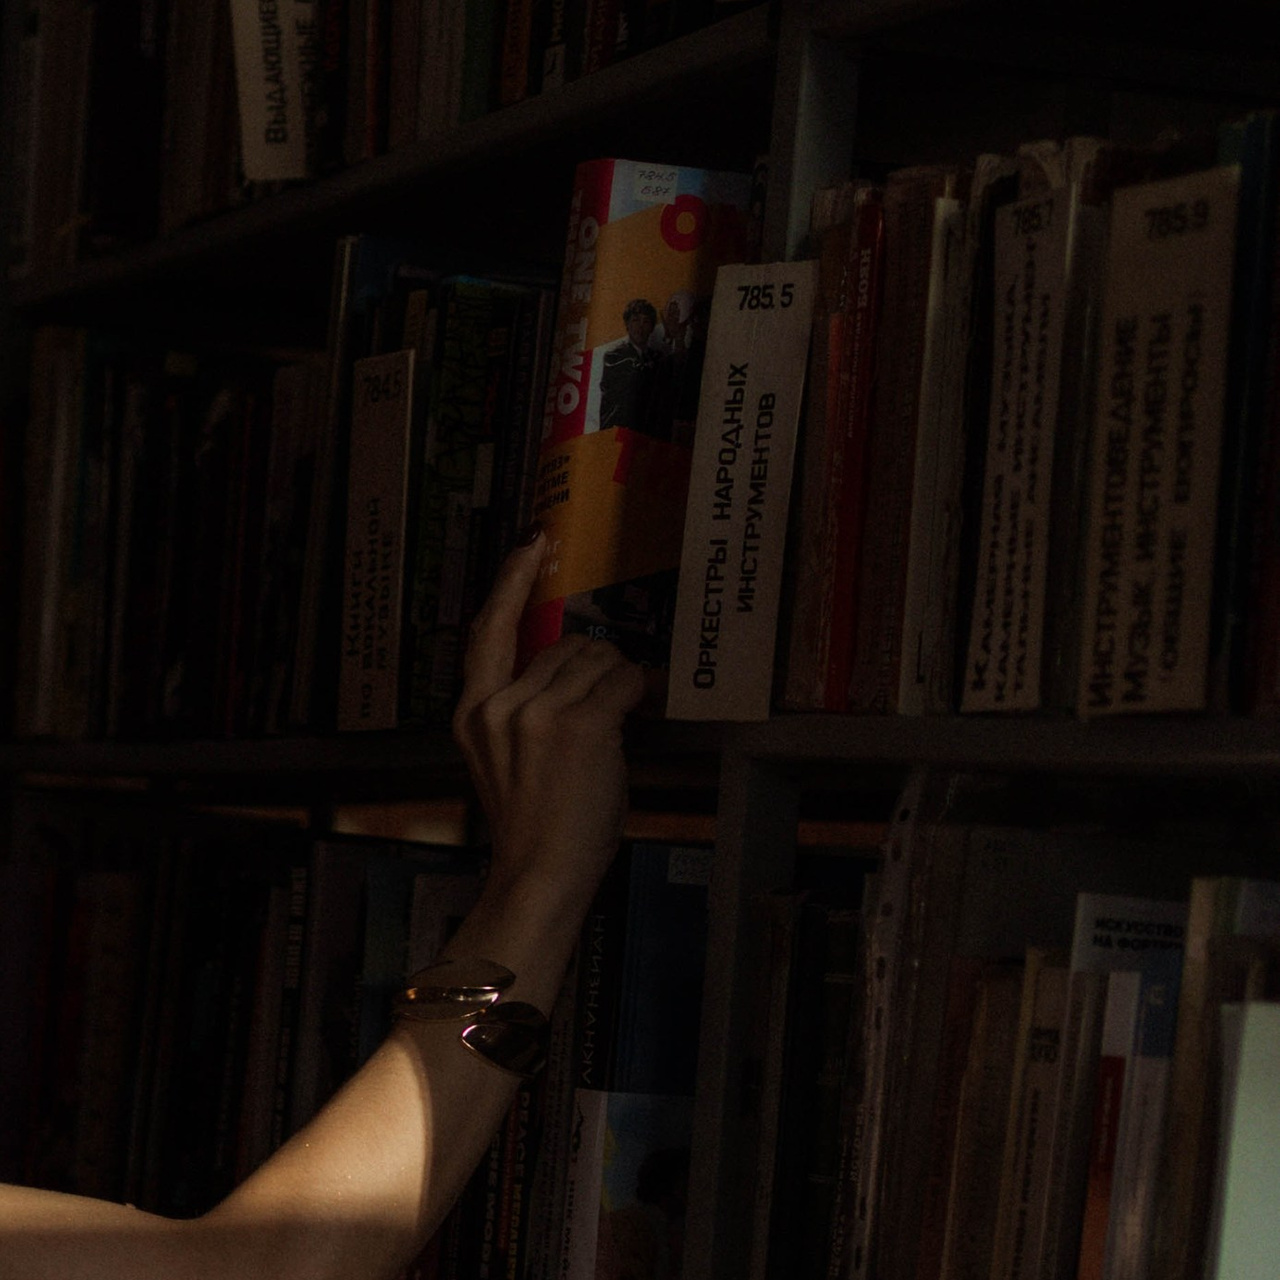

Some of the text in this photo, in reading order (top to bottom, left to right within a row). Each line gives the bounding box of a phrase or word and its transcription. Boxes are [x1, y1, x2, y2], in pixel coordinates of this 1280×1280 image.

[556, 215, 599, 417] ONE TWO
[693, 362, 750, 691] ОРКЕСТРЫ НАРОДНЫХ
[735, 391, 777, 614] ИНСТРУМЕНТОВ
